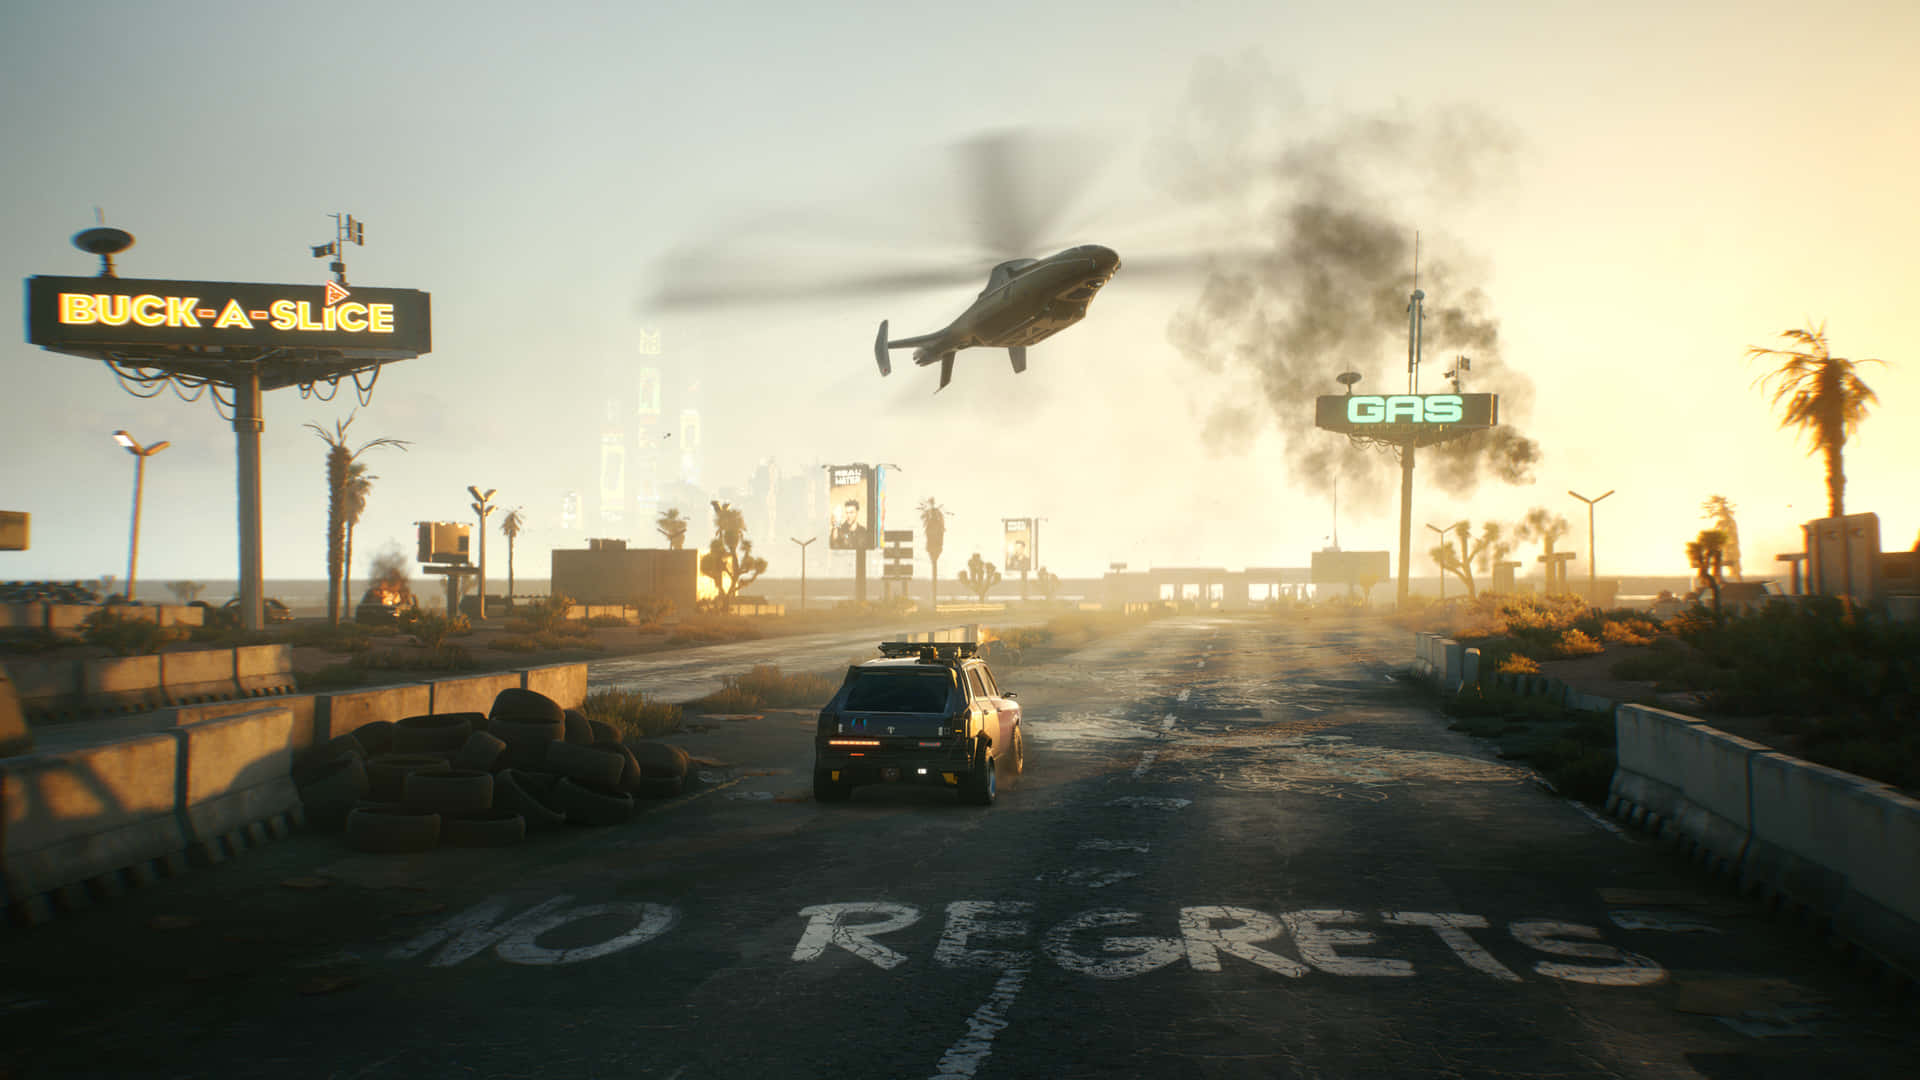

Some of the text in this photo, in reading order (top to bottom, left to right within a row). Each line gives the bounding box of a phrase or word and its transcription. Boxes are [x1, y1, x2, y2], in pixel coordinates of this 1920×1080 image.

[58, 284, 394, 332] BUCK-A-SLICE
[1347, 395, 1463, 423] GAS
[385, 895, 1667, 987] NO REGRETS
